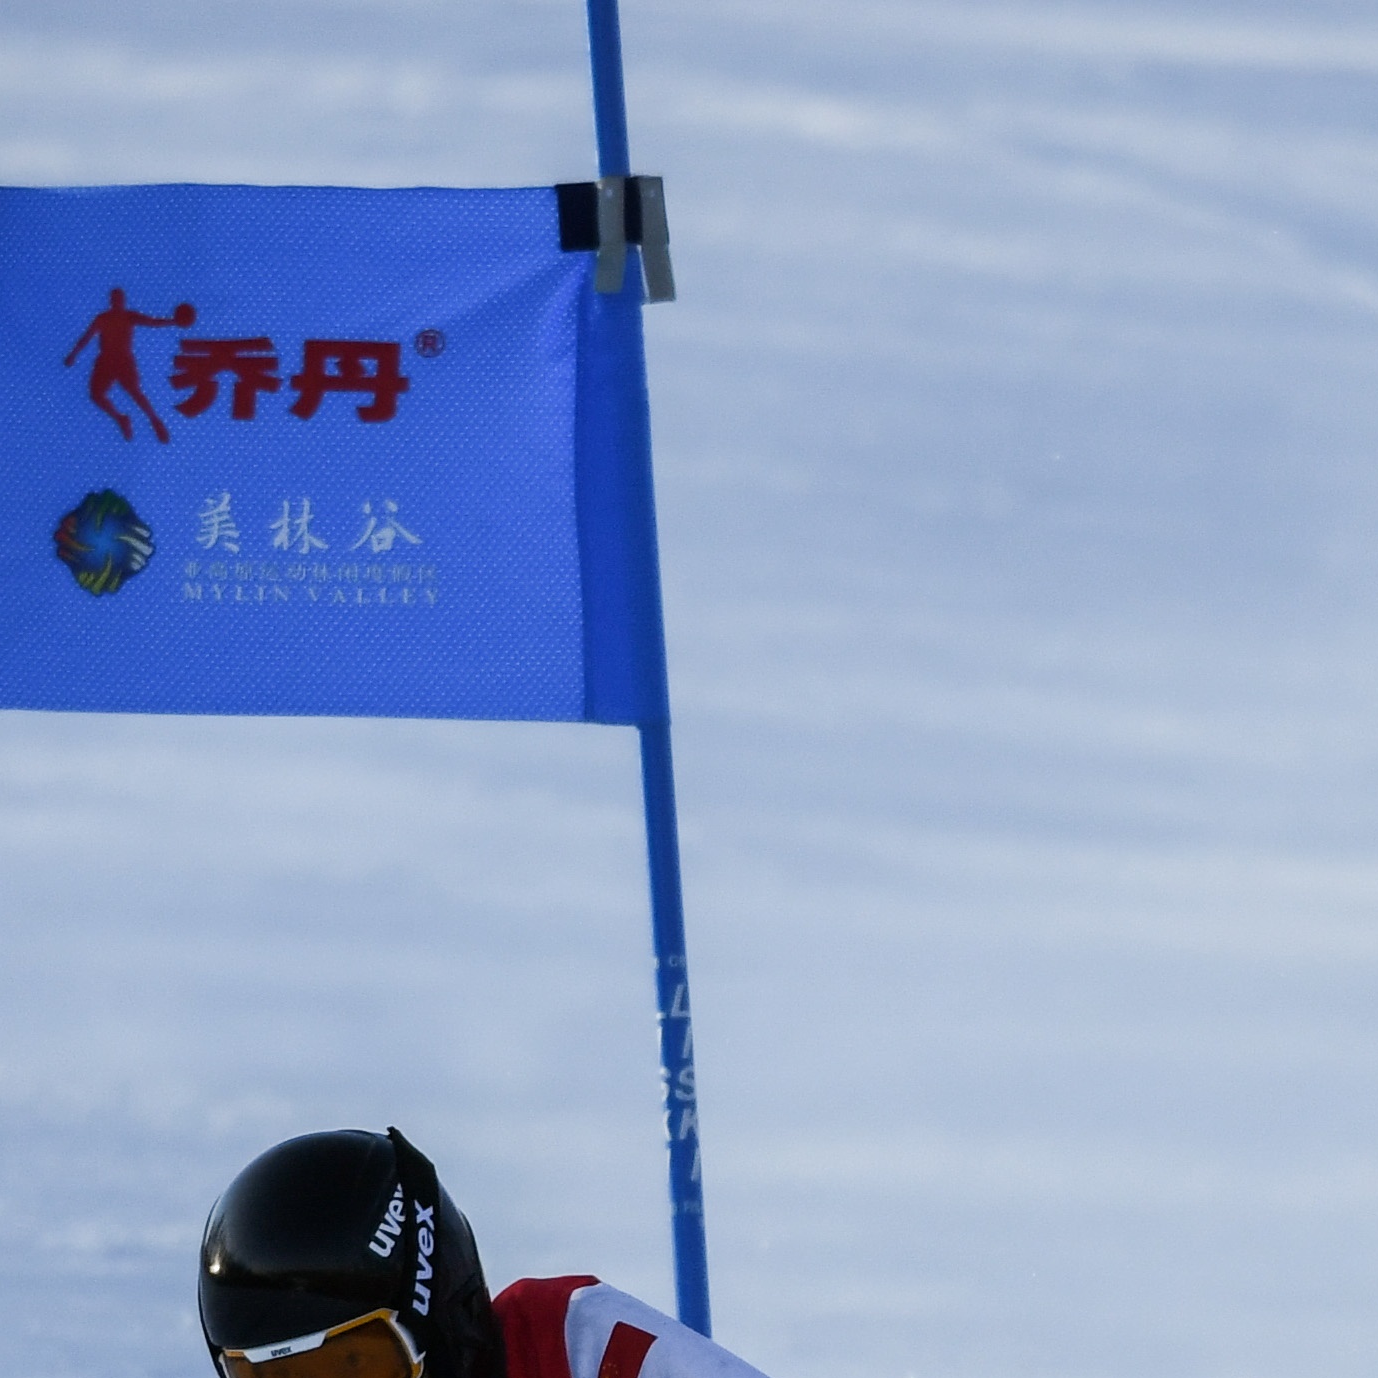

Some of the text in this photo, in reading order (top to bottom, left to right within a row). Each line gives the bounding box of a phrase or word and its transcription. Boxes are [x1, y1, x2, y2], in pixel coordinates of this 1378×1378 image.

[168, 337, 410, 423] 乔丹
[196, 493, 423, 555] 美林谷
[183, 582, 439, 608] MYLIN VALLEY
[412, 1199, 435, 1317] uvex
